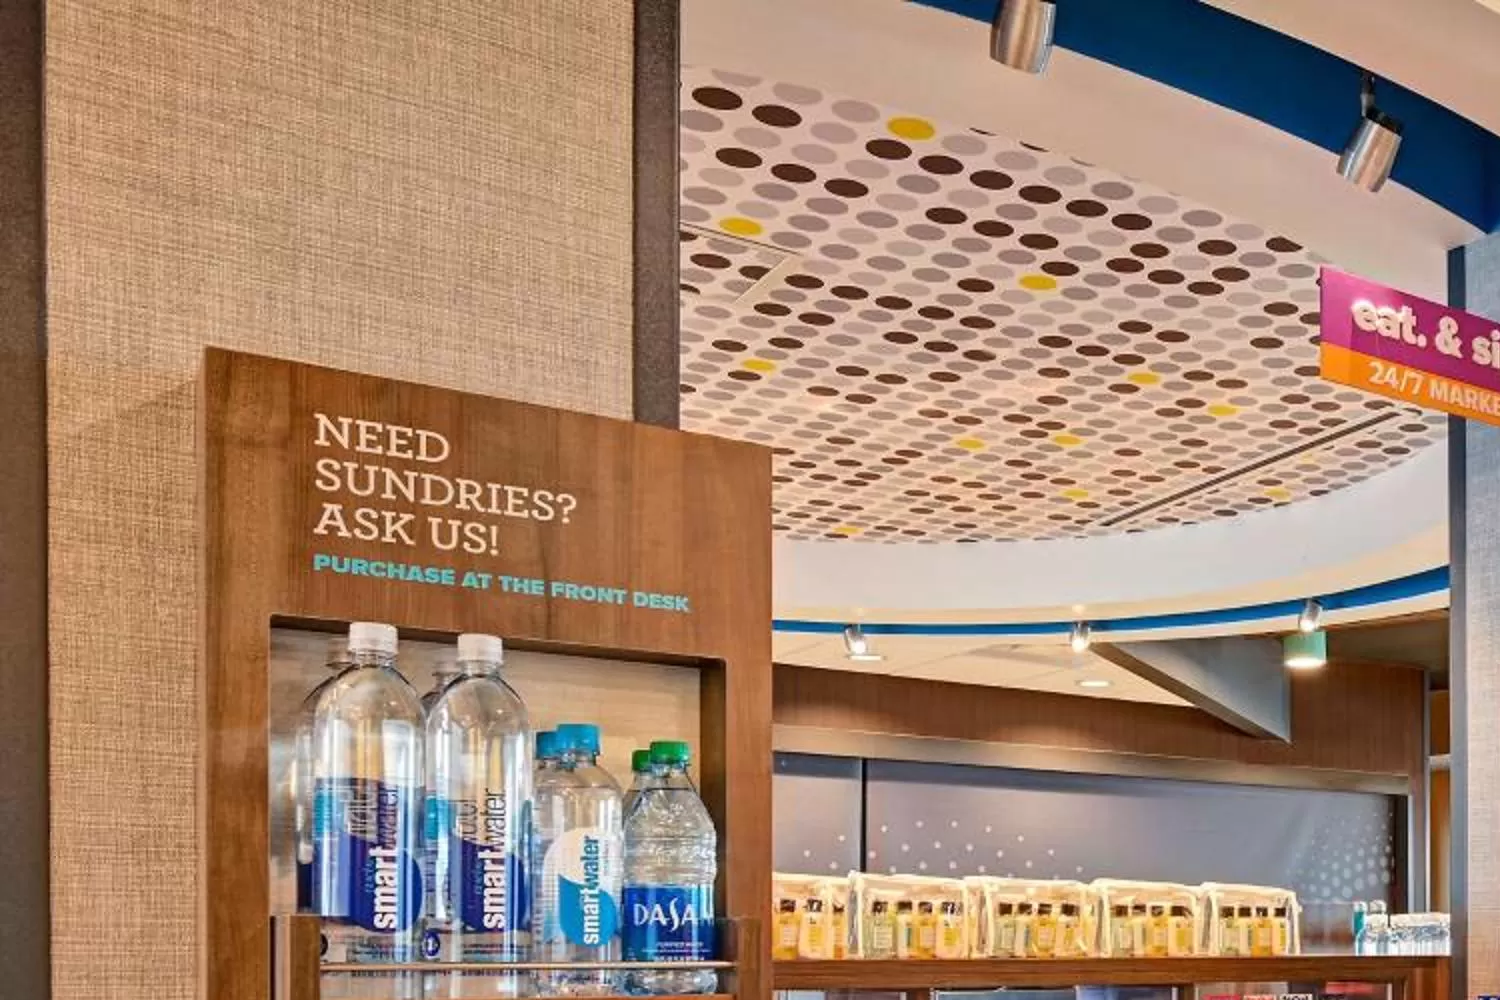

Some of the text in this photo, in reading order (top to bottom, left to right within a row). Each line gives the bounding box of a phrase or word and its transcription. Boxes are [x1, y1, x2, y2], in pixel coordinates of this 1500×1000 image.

[1351, 300, 1427, 348] eat.
[1435, 316, 1463, 359] &
[1368, 361, 1424, 394] 24/7
[314, 413, 449, 463] NEED
[314, 459, 577, 524] SUNDRIES?
[314, 504, 499, 556] ASK US!
[314, 553, 690, 613] PURCHASE AT THE FRONT DESK
